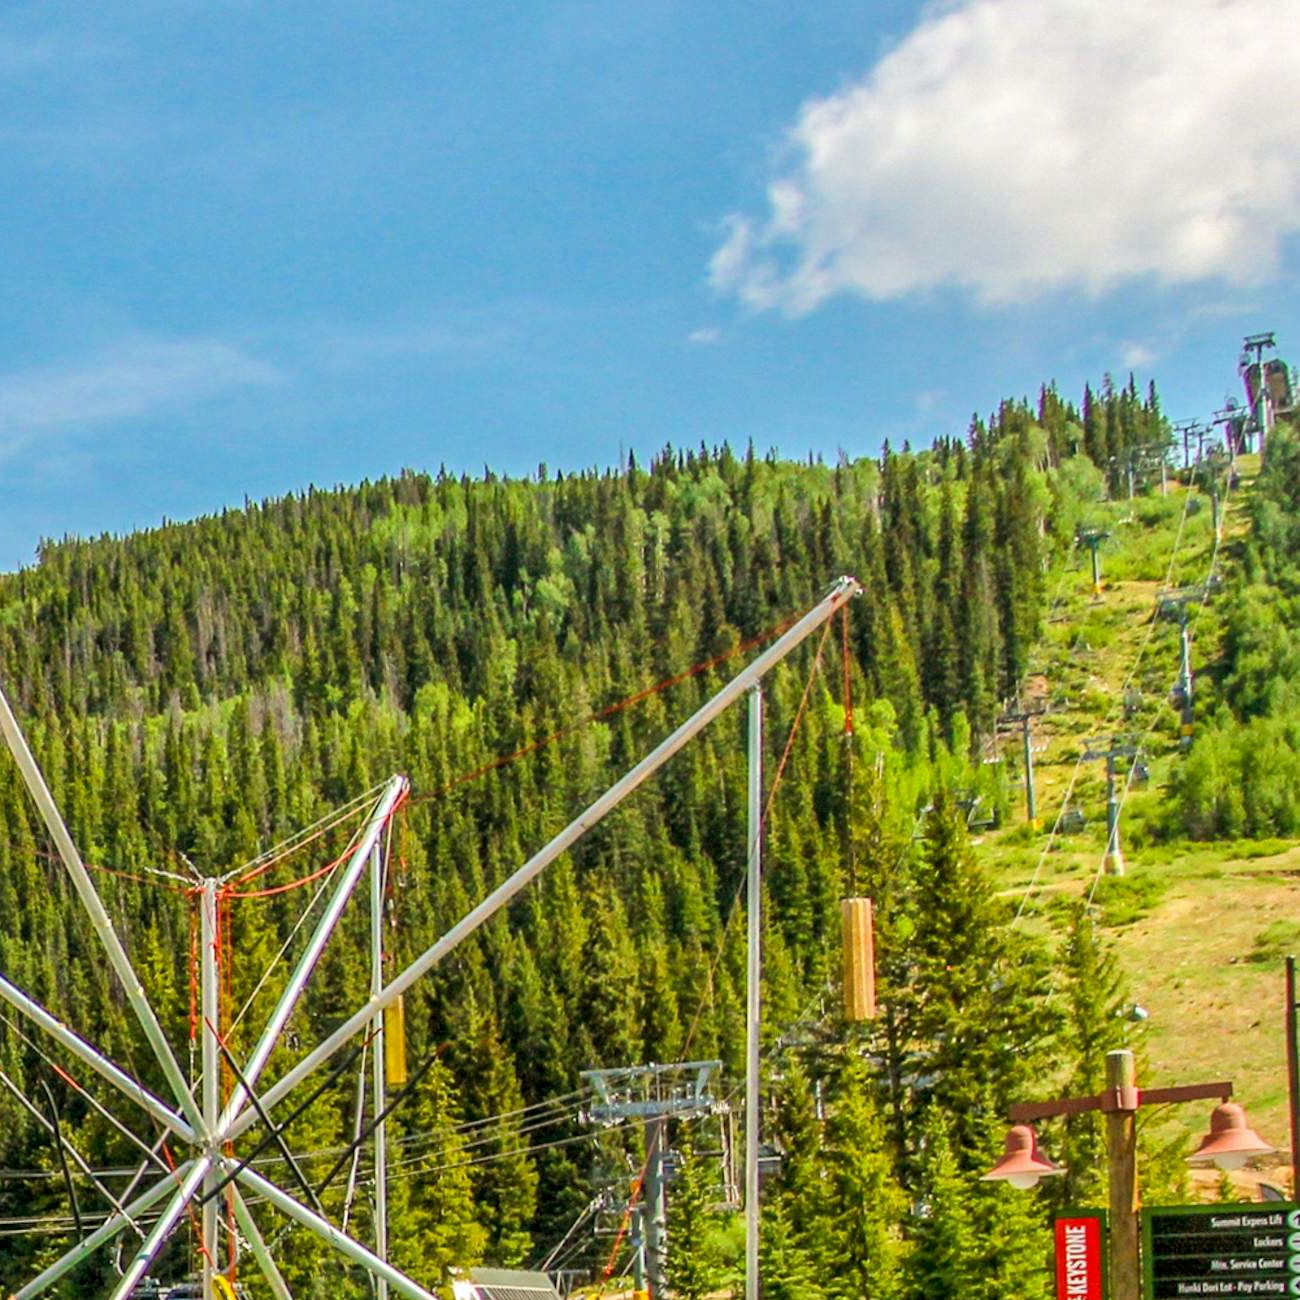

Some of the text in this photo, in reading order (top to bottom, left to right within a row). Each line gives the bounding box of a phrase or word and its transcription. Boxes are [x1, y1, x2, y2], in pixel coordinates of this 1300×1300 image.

[1269, 1214, 1283, 1225] Lift
[1254, 1236, 1284, 1247] Lockers
[1065, 1225, 1087, 1294] KEYSTONE
[1230, 1259, 1257, 1270] Service
[1258, 1258, 1284, 1269] Center
[1253, 1280, 1285, 1293] Parking
